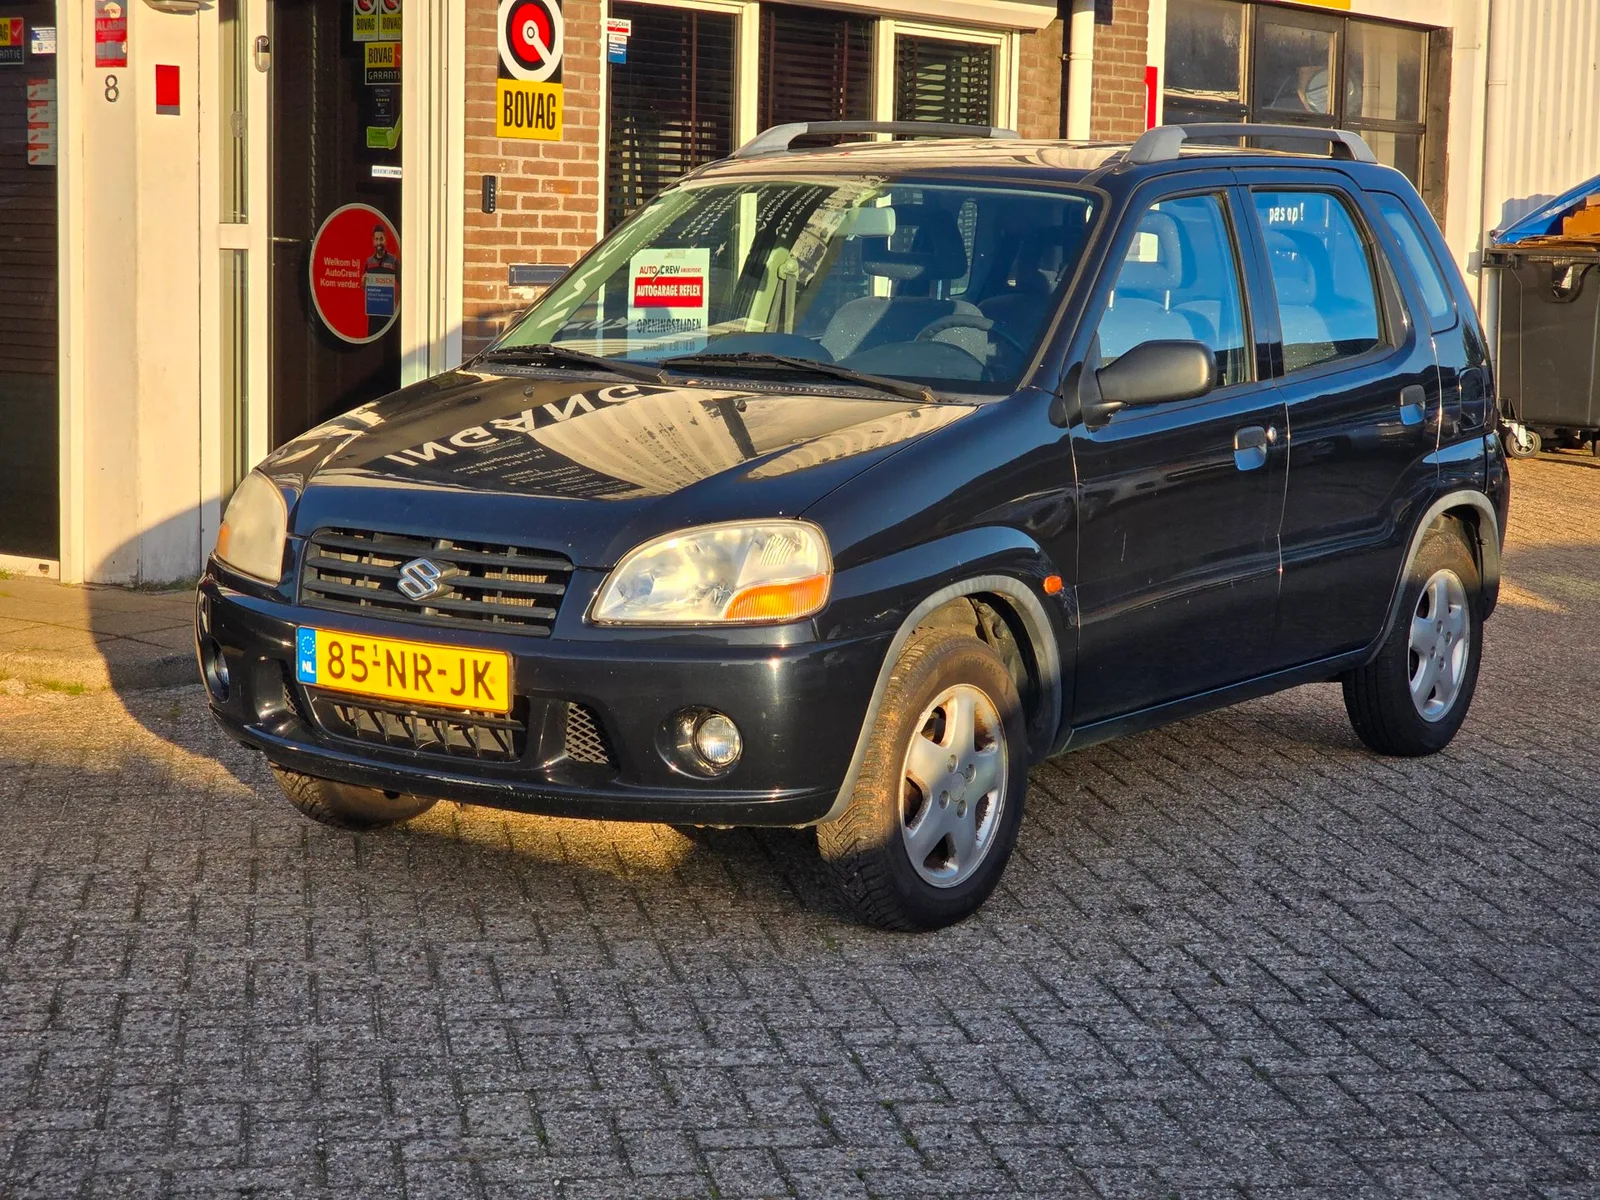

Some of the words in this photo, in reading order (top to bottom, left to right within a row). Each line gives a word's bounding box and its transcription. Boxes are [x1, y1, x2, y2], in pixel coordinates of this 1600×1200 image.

[356, 18, 375, 31] BOVAG
[368, 47, 393, 64] BOVAG
[368, 70, 400, 81] GARANTI
[104, 74, 120, 103] 8
[504, 90, 556, 131] BOVAG
[1269, 206, 1286, 225] pas
[323, 257, 351, 267] Welkom
[639, 266, 657, 275] AUTO
[660, 265, 680, 275] CREW
[320, 278, 336, 287] Kom
[636, 285, 678, 297] AUTOGARAGE
[679, 284, 701, 297] REFLEX
[636, 318, 702, 333] OPENINGSTIJDEN
[302, 660, 315, 674] NL
